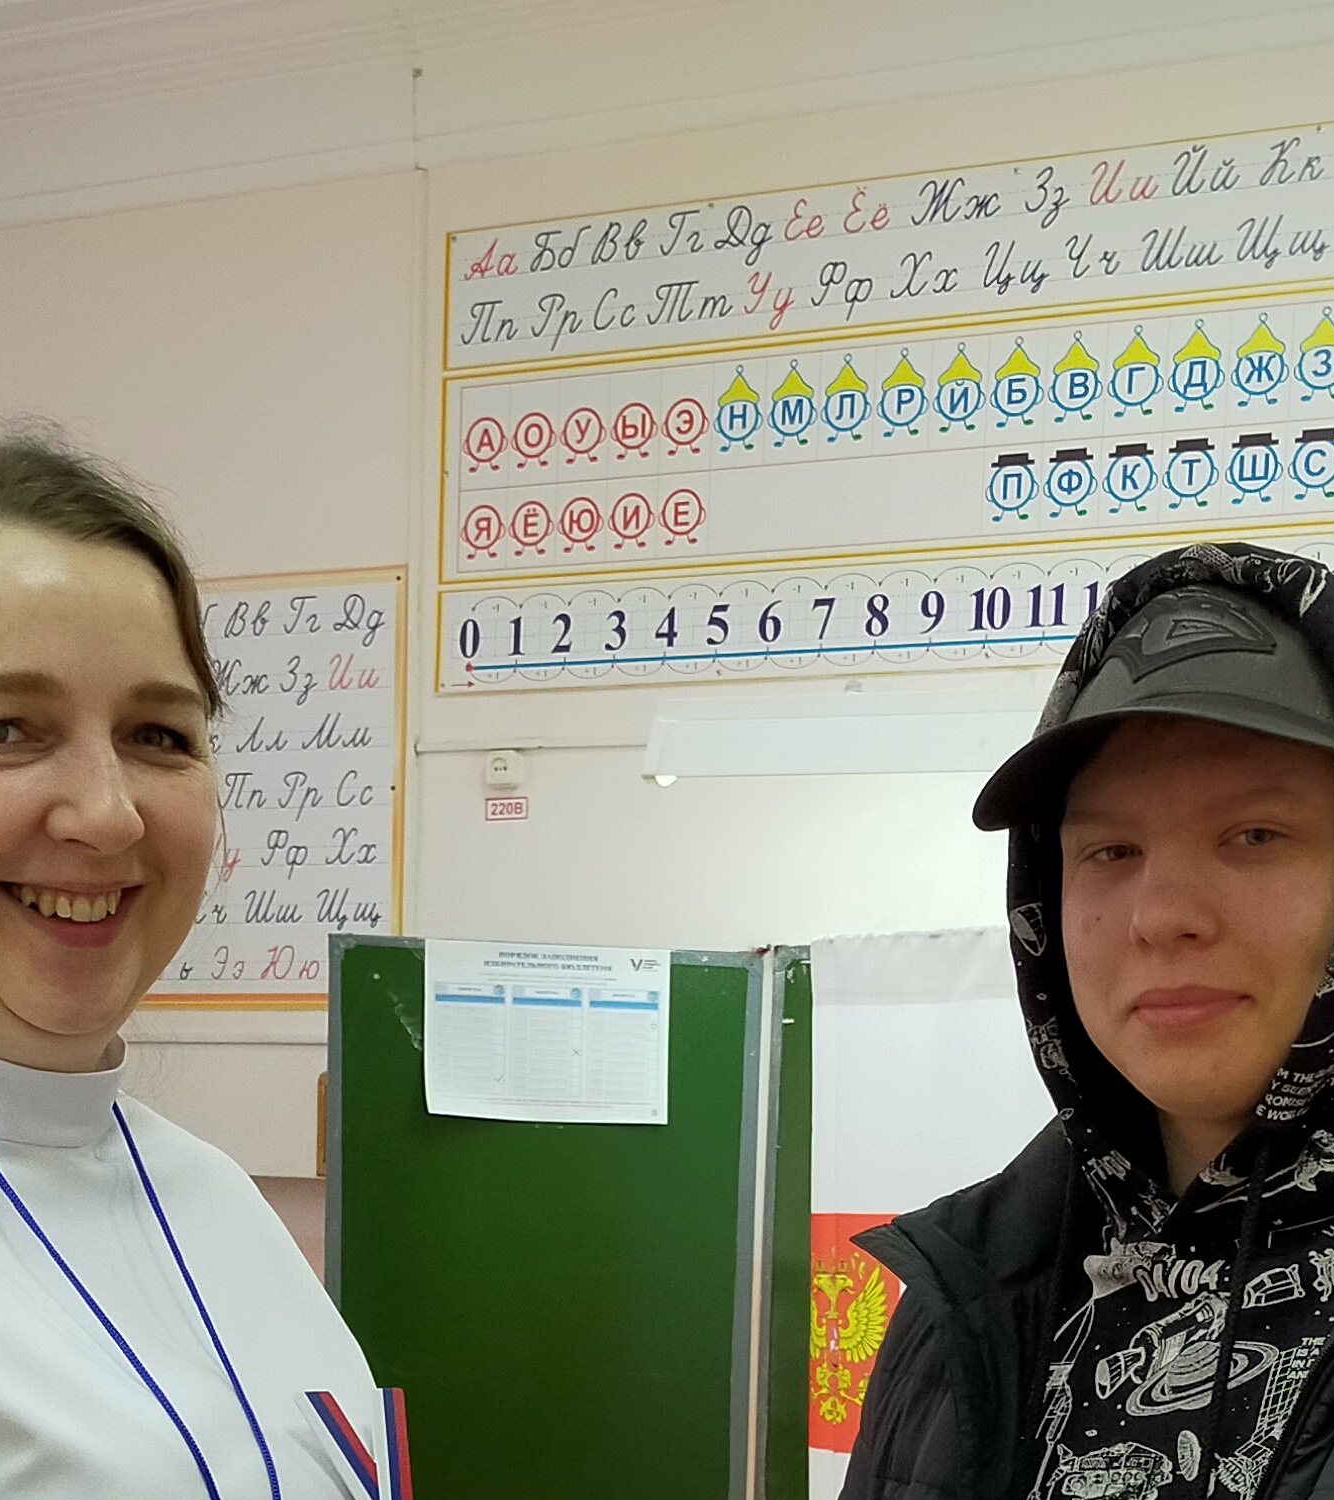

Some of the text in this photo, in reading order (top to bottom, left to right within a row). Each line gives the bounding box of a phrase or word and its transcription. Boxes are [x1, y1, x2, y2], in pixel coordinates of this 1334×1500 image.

[475, 430, 494, 452] А
[525, 424, 544, 447] О
[575, 418, 592, 440] У
[622, 418, 648, 438] Ы
[676, 410, 695, 432] Э
[728, 409, 747, 430] Н
[782, 399, 804, 425] М
[835, 394, 856, 419] Л
[896, 388, 915, 415] Р
[949, 380, 969, 414] Й
[1006, 378, 1027, 404] Б
[1069, 372, 1088, 399] В
[1126, 366, 1142, 395] Г
[1185, 361, 1208, 392] Д
[1245, 355, 1275, 383] Ж
[1312, 350, 1332, 377] З
[475, 518, 492, 540] Я
[523, 508, 540, 538] Ё
[567, 509, 597, 532] Ю
[622, 506, 642, 530] И
[674, 501, 691, 526] Е
[1002, 474, 1022, 500] П
[1062, 468, 1082, 496] Ф
[1120, 463, 1140, 490] К
[1182, 458, 1201, 486] Т
[1239, 453, 1269, 481] Ш
[1305, 449, 1326, 476] С
[460, 619, 479, 658] 0
[508, 616, 525, 656] 1
[551, 613, 572, 653] 2
[605, 610, 626, 651] 3
[655, 606, 677, 647] 4
[706, 604, 730, 646] 5
[758, 600, 782, 643] 6
[811, 597, 836, 640] 7
[866, 594, 889, 637] 8
[920, 591, 945, 634] 9
[968, 586, 1011, 632] 10
[1026, 583, 1068, 628] 11
[1084, 581, 1099, 617] 1
[491, 802, 524, 816] 220В
